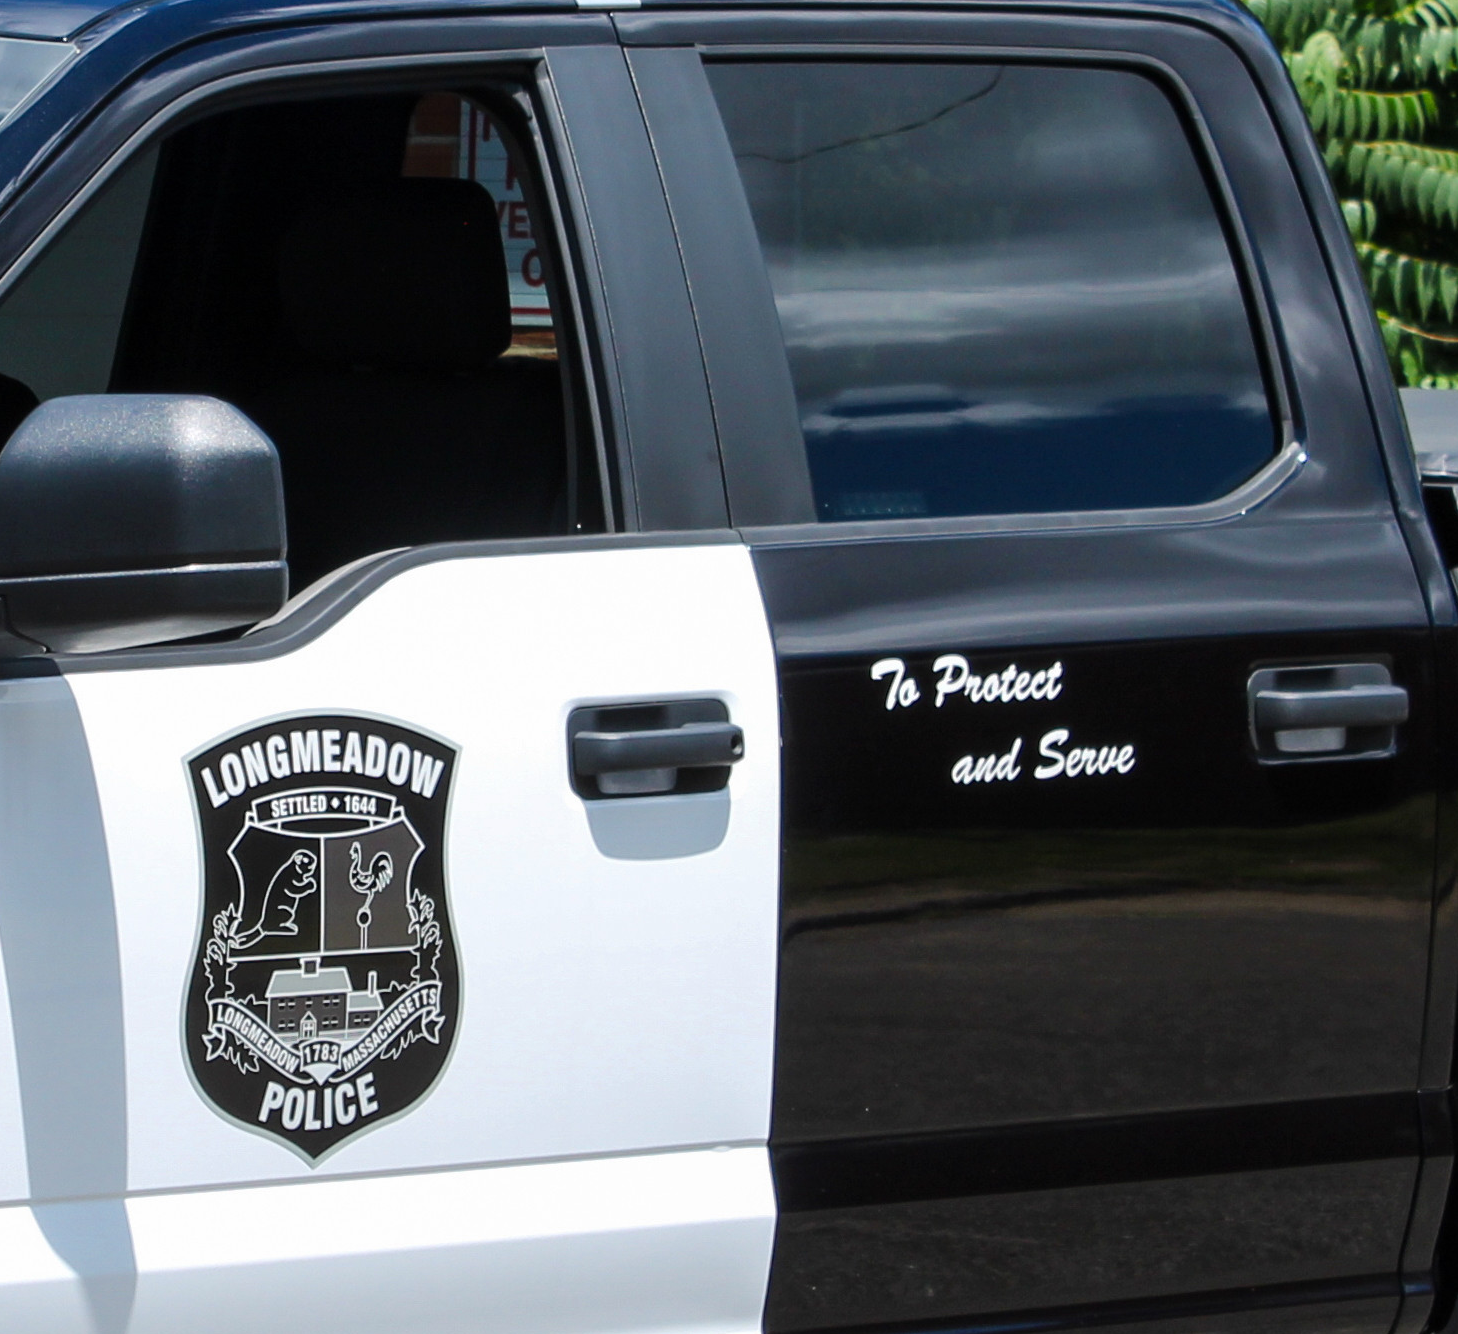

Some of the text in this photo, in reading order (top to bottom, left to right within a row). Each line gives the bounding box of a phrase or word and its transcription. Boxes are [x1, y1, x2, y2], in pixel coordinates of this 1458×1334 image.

[871, 653, 1065, 711] To Protect
[200, 729, 445, 809] LONGMEADOW
[950, 728, 1136, 786] and Serve
[270, 794, 377, 818] SETTLED 1644
[217, 1004, 301, 1074] LONGMEADOW
[304, 1044, 339, 1064] 1783
[341, 986, 437, 1073] MASSACHUSETTS
[258, 1071, 379, 1132] POLICE
